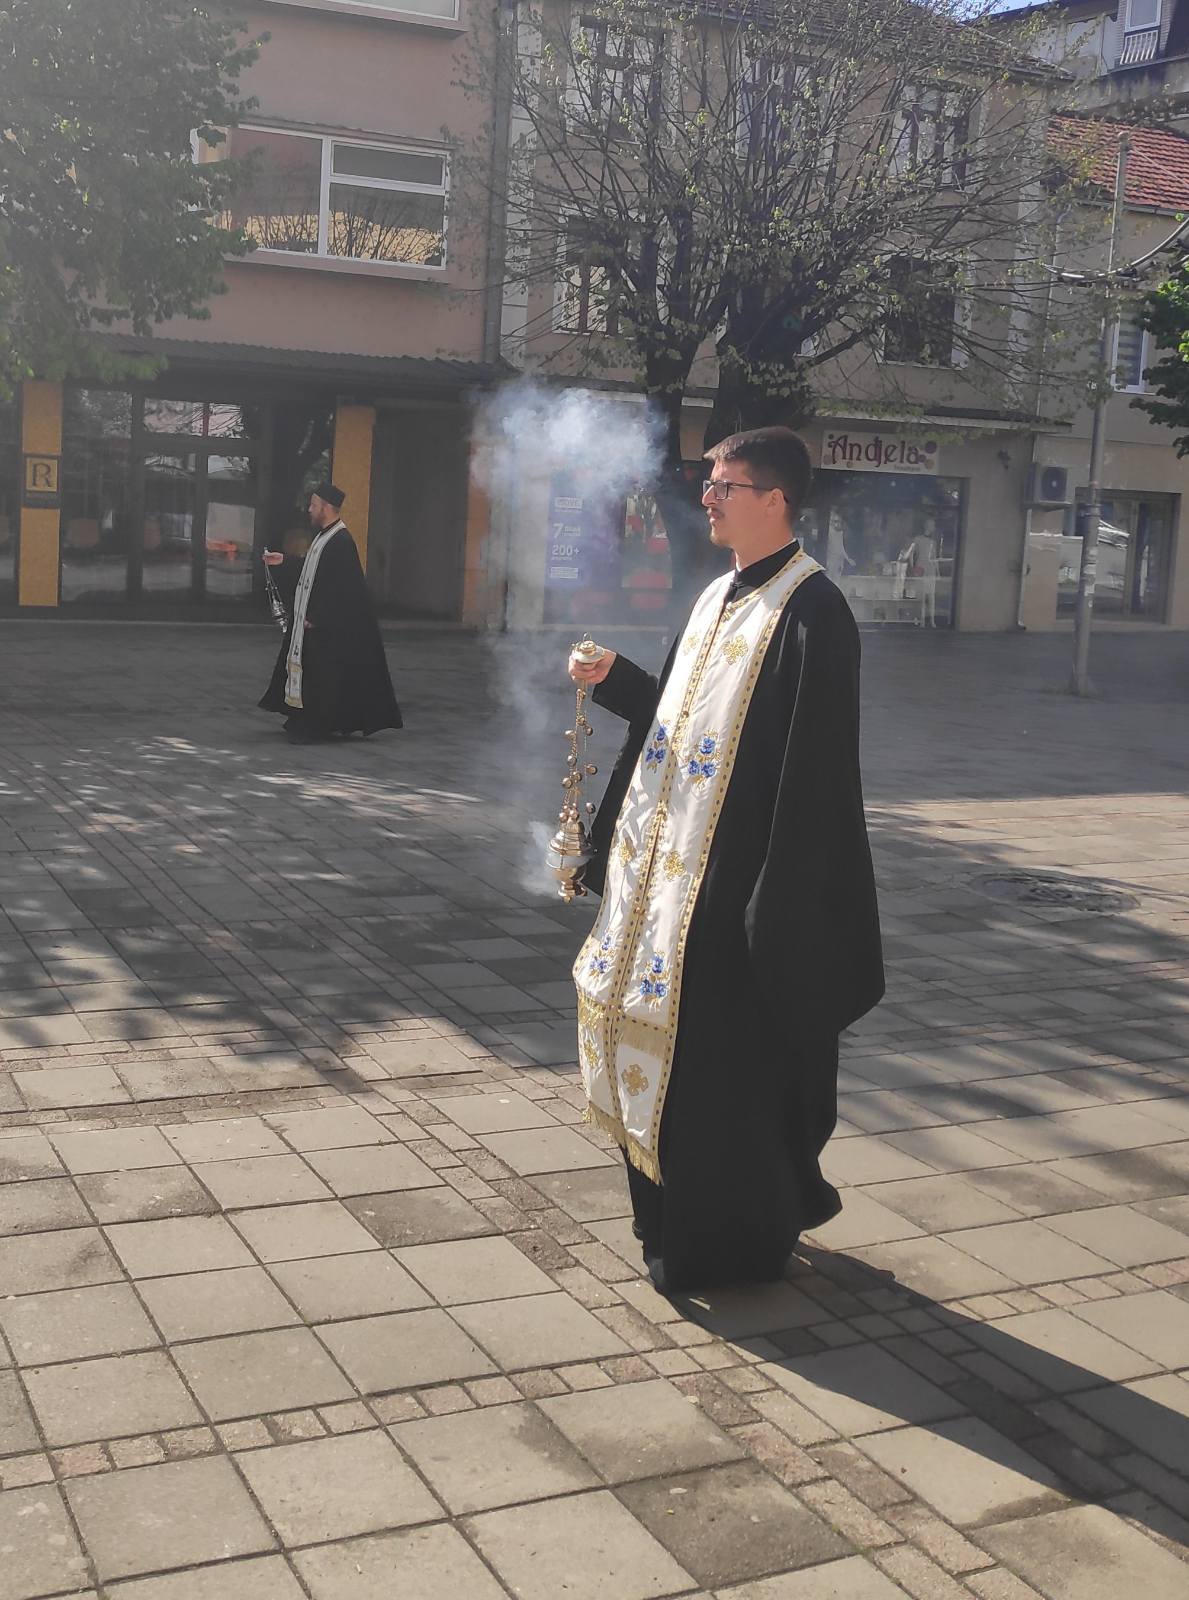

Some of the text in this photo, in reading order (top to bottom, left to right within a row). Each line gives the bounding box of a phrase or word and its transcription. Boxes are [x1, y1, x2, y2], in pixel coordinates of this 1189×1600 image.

[32, 463, 53, 487] R
[553, 523, 564, 538] 7
[552, 544, 579, 556] 200+
